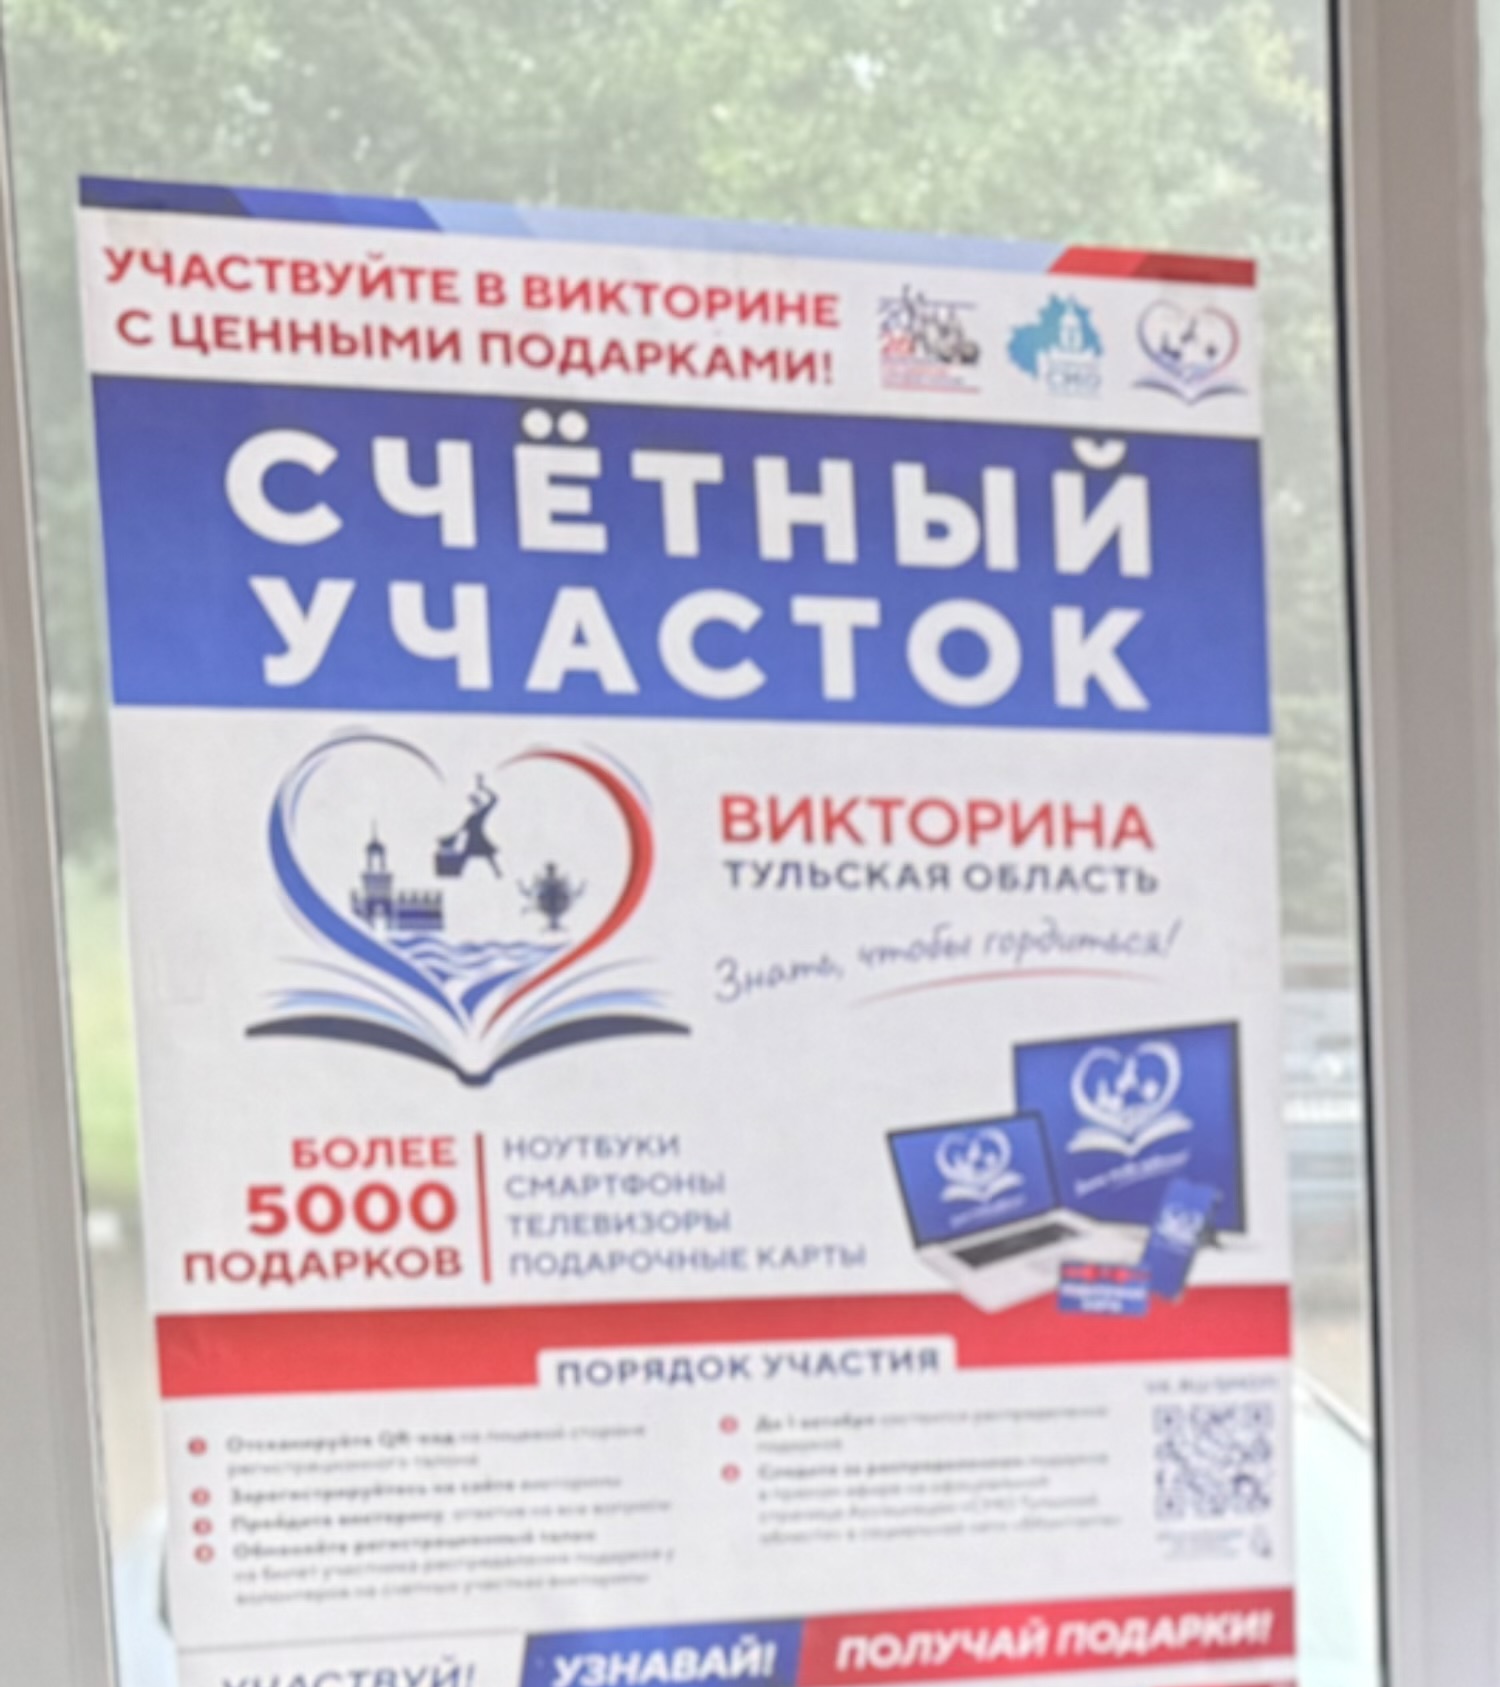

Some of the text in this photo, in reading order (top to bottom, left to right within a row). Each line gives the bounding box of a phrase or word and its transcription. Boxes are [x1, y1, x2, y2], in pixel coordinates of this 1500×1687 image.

[103, 245, 840, 329] УЧАСТВУЙТЕ В ВИКТОРИНЕ
[115, 307, 153, 347] С
[169, 312, 462, 365] ЦЕННЫМИ
[478, 330, 834, 387] ПОДАРКАМИ!
[224, 407, 1153, 579] СЧЁТНЫЙ
[249, 575, 1150, 712] УЧАСТОК
[717, 793, 1156, 853] ВИКТОРИНА
[723, 859, 1160, 896] ТУЛЬСКАЯ ОБЛАСТЬ
[714, 917, 1184, 1005] Знать, чтобы гордиться!
[292, 1135, 458, 1172] БОЛЕЕ
[504, 1134, 681, 1163] НОУТБУКИ
[246, 1181, 459, 1237] 5000
[504, 1171, 727, 1201] СМАРТФОНЫ
[506, 1210, 732, 1239] ТЕЛЕВИЗОРЫ
[185, 1247, 464, 1288] ПОДАРКОВ
[509, 1244, 867, 1279] ПОДАРОЧНЫЕ КАРТЫ
[557, 1345, 940, 1389] ПОРЯДОК УЧАСТИЯ
[834, 1610, 1274, 1675] ПОЛУЧАЙ ПОДАРКИ!
